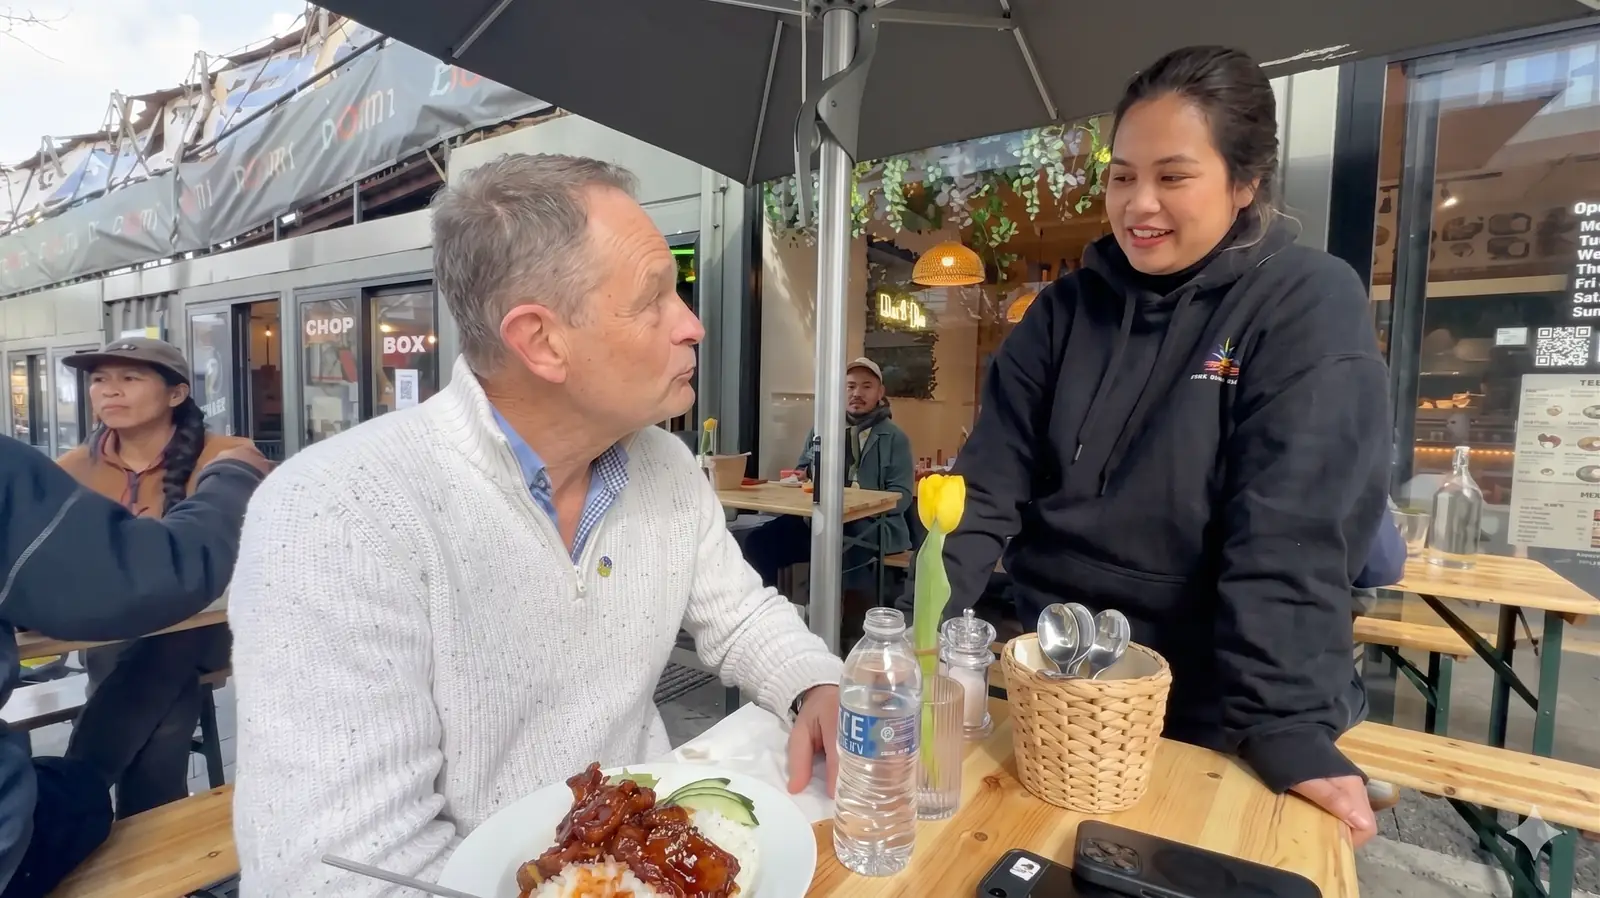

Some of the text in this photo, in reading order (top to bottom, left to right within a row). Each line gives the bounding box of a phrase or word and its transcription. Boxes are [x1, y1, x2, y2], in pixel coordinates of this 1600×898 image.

[1575, 277, 1596, 289] Fri
[306, 317, 354, 336] CHOP
[383, 335, 426, 354] BOX
